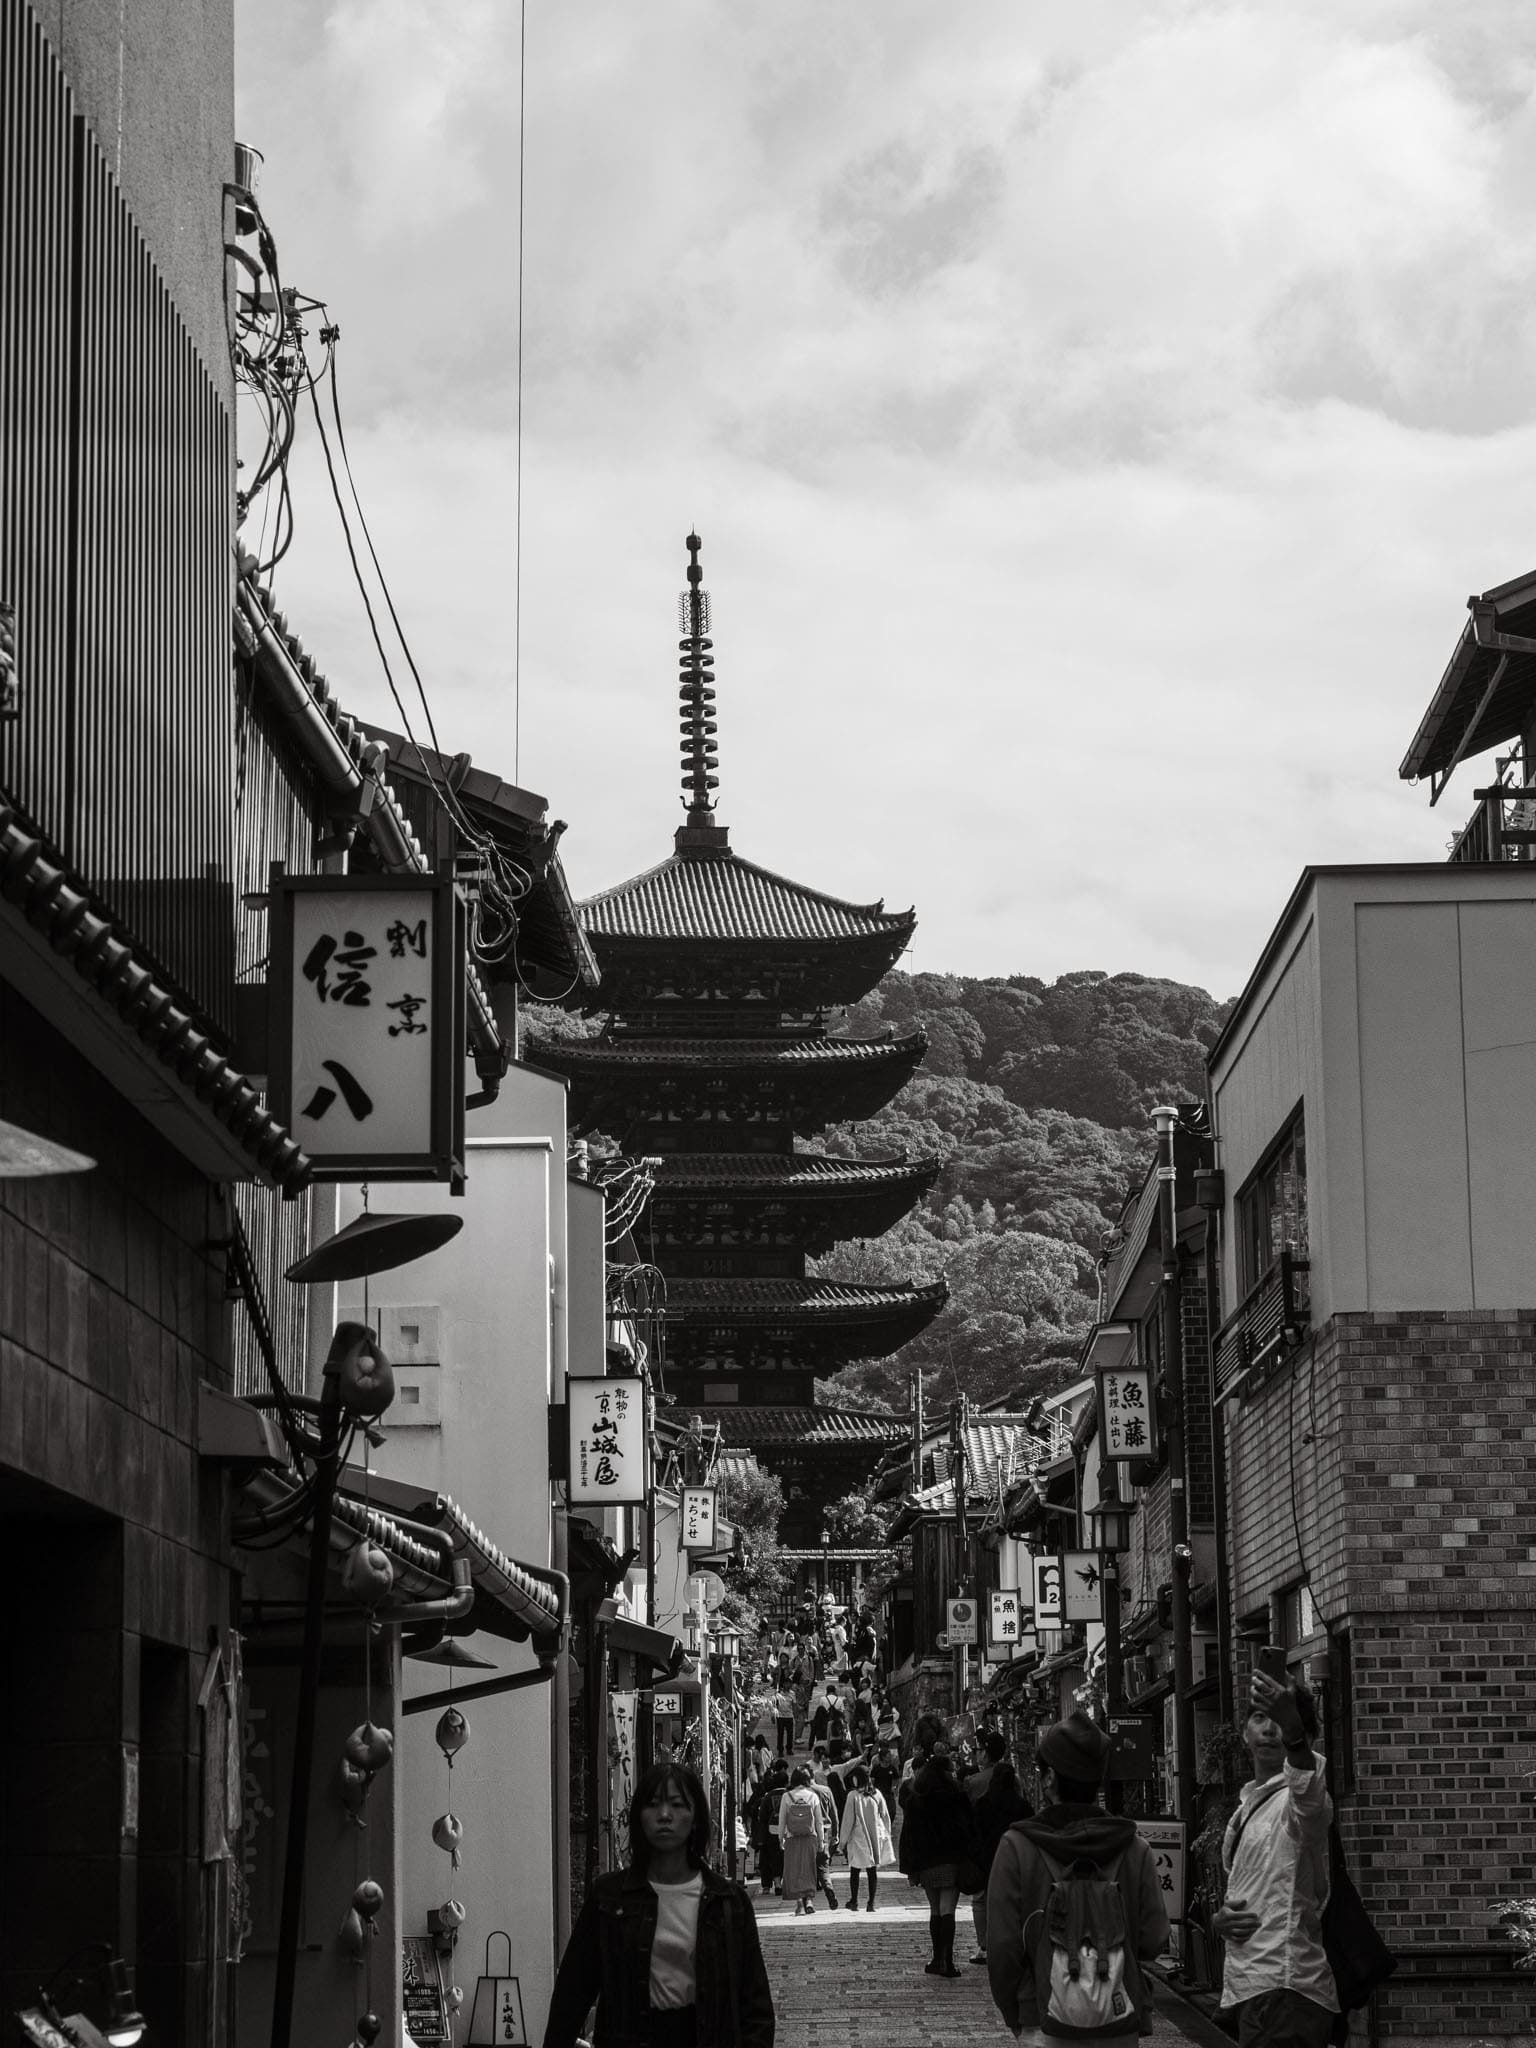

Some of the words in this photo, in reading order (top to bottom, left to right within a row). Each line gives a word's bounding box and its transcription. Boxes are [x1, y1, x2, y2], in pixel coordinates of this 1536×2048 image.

[385, 919, 428, 1038] 割烹
[302, 930, 378, 1121] 信八
[1121, 1381, 1148, 1447] 魚藤
[687, 1504, 699, 1539] ちとせ
[1002, 1599, 1017, 1635] 魚捨
